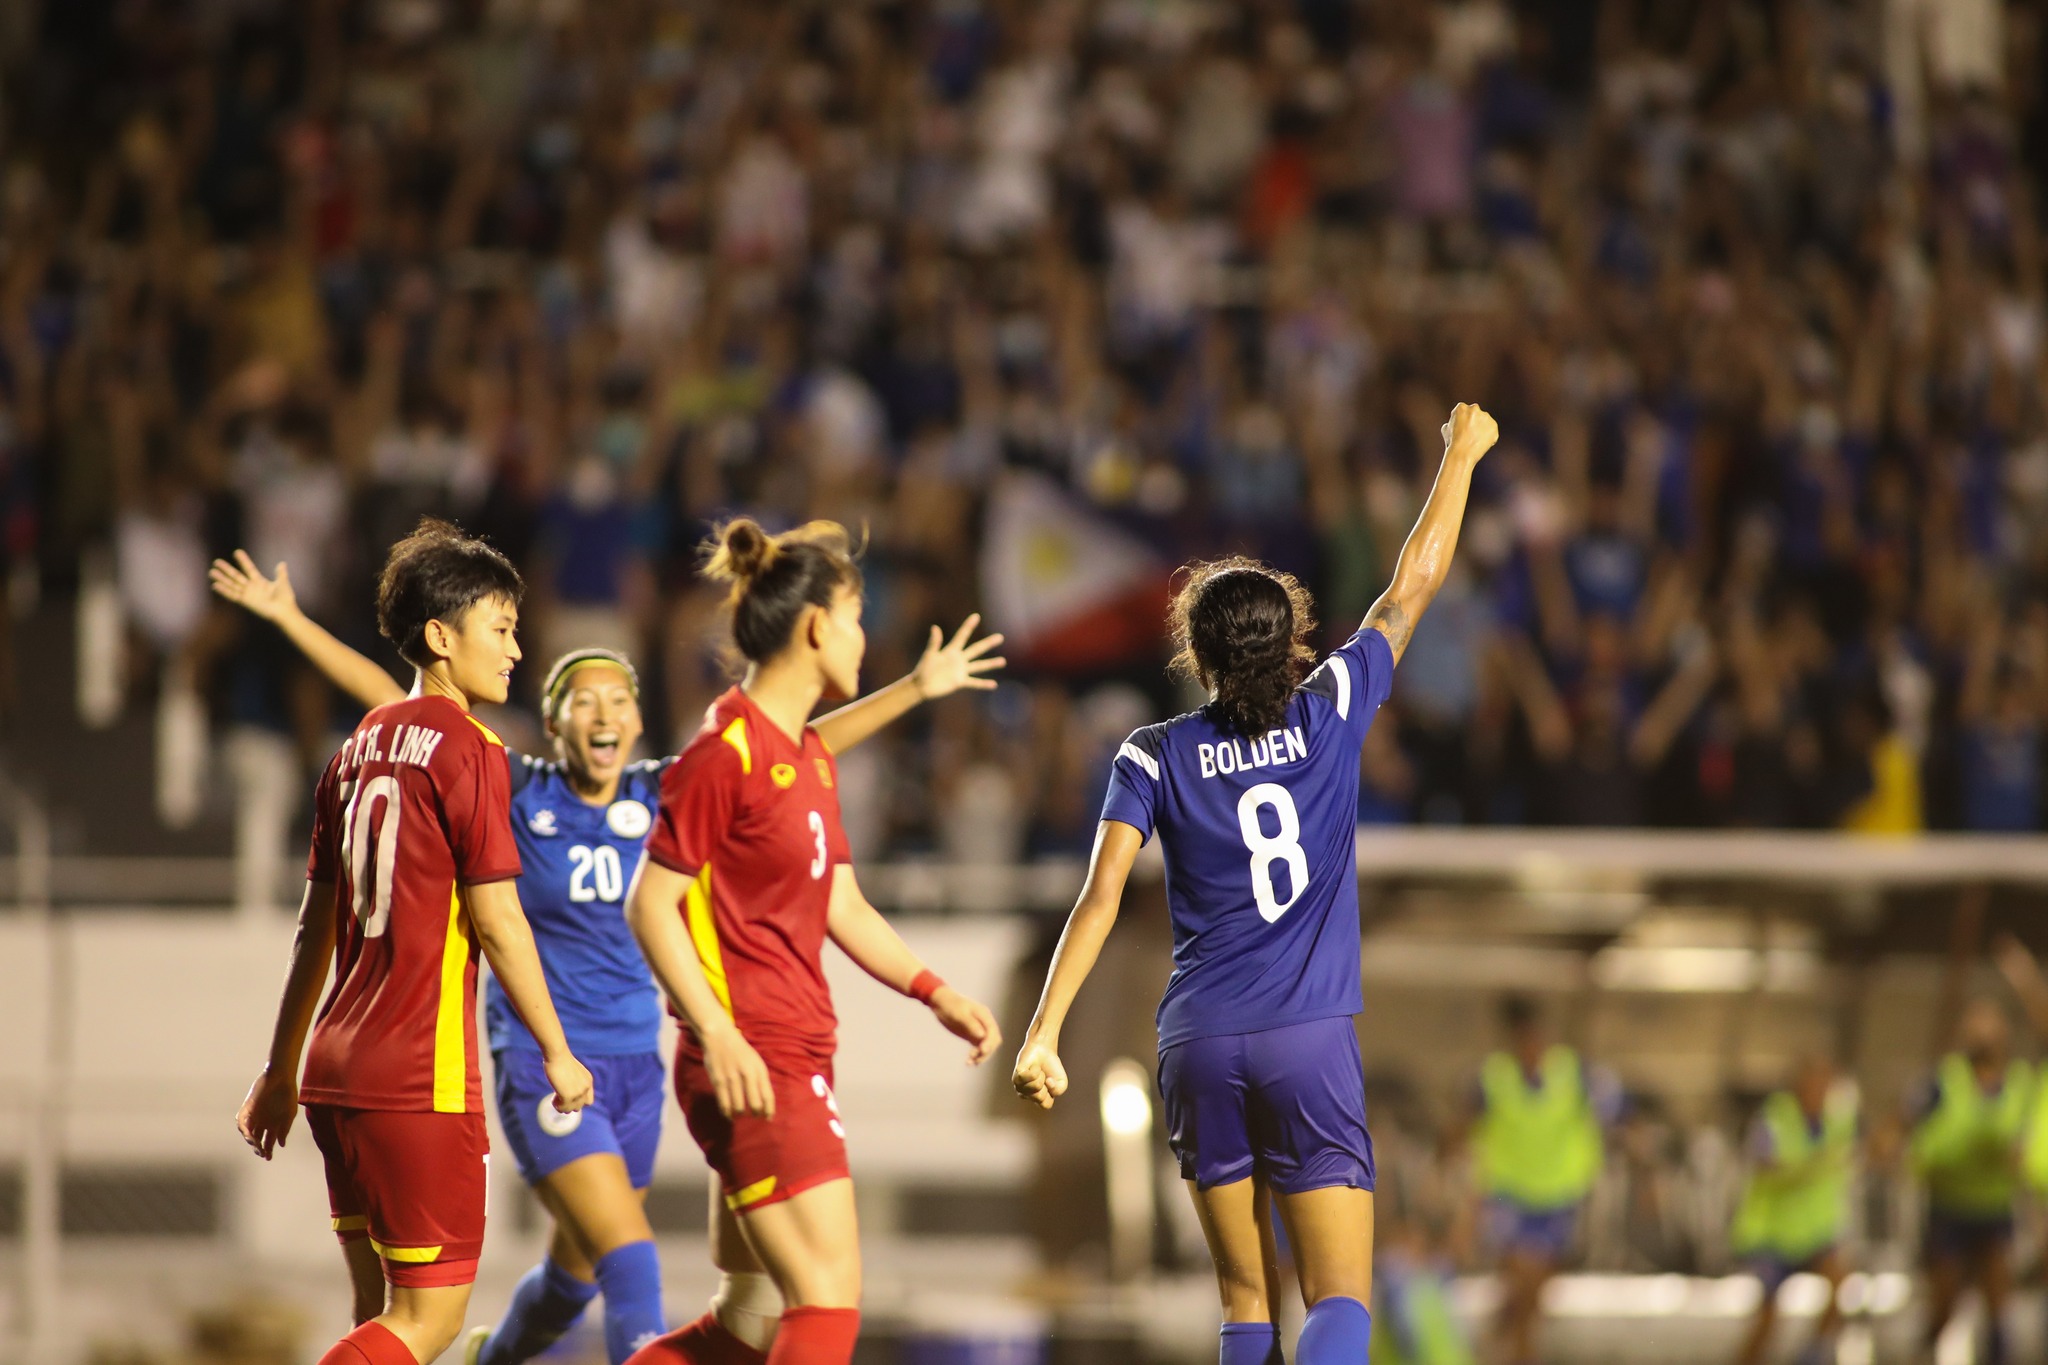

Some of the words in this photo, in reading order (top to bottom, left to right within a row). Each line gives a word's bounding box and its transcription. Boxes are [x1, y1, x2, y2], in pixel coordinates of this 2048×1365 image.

[388, 724, 443, 767] LINH
[1199, 726, 1308, 778] BOLDEN
[569, 845, 623, 903] 20
[808, 811, 827, 880] 3
[1237, 782, 1310, 924] 8
